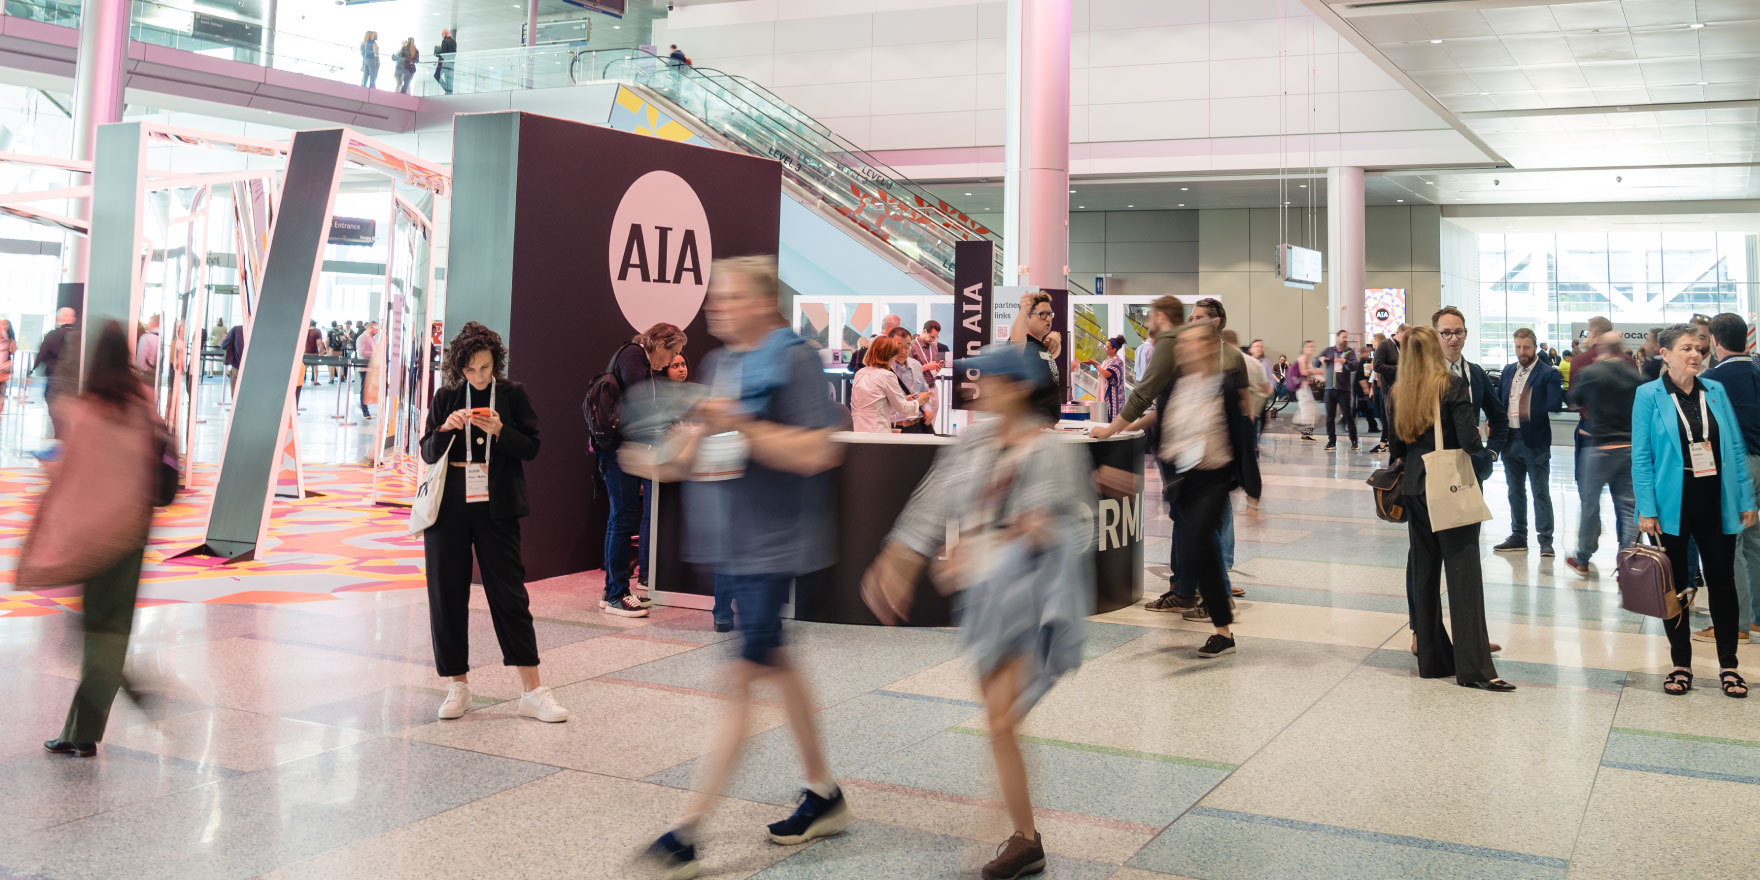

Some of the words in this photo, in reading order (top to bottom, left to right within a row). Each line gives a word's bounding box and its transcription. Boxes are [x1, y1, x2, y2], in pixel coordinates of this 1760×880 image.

[768, 146, 793, 168] LEVEL
[794, 163, 802, 172] 3
[334, 222, 361, 230] Entrance
[617, 223, 703, 285] AIA
[962, 282, 983, 334] AIA
[994, 311, 1011, 319] links
[961, 340, 982, 400] Jon
